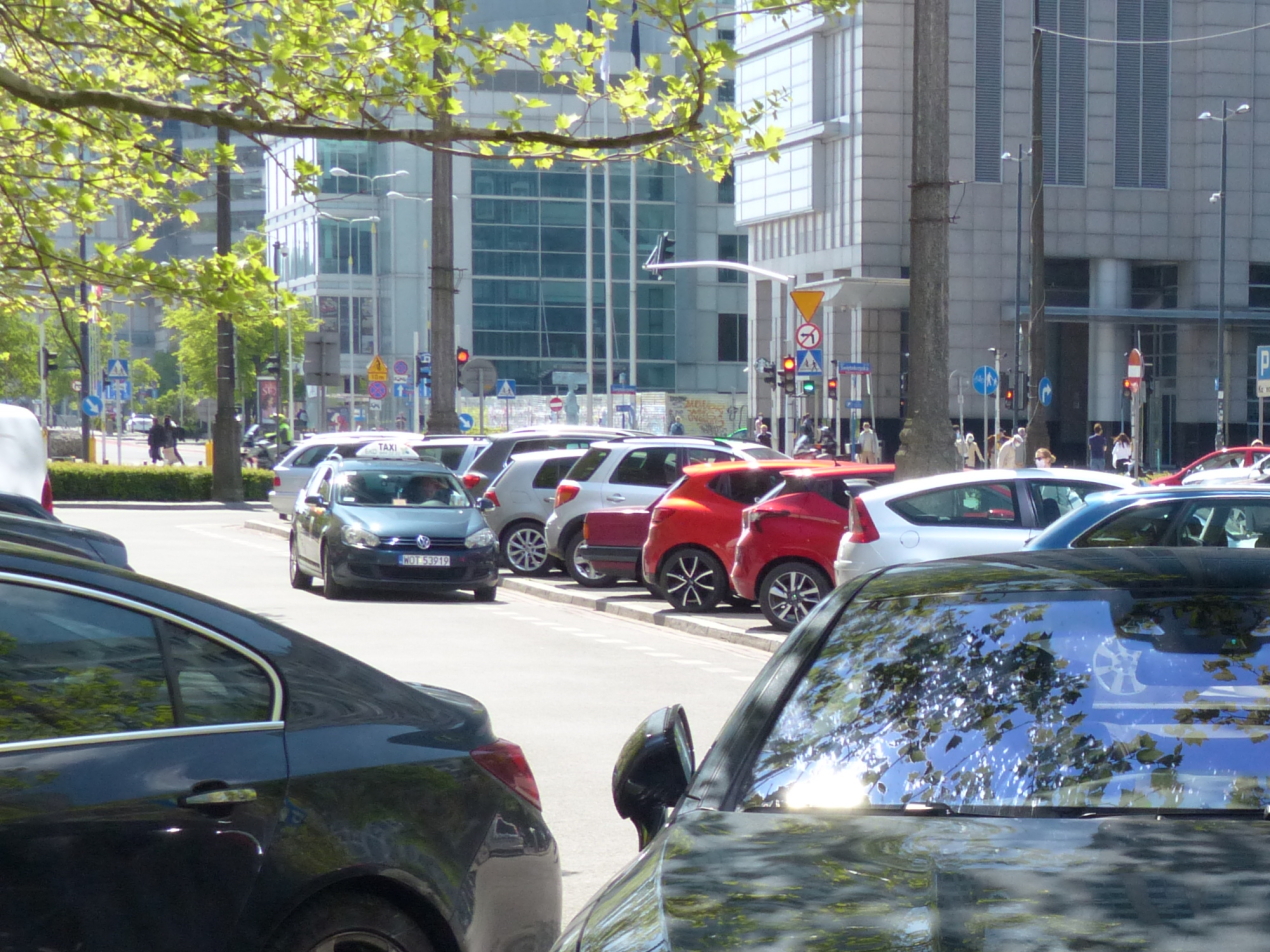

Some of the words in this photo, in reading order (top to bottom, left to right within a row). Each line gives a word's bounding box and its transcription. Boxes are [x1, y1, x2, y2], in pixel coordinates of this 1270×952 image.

[1260, 350, 1270, 376] P
[378, 443, 397, 452] TAXI
[423, 556, 449, 566] 53919
